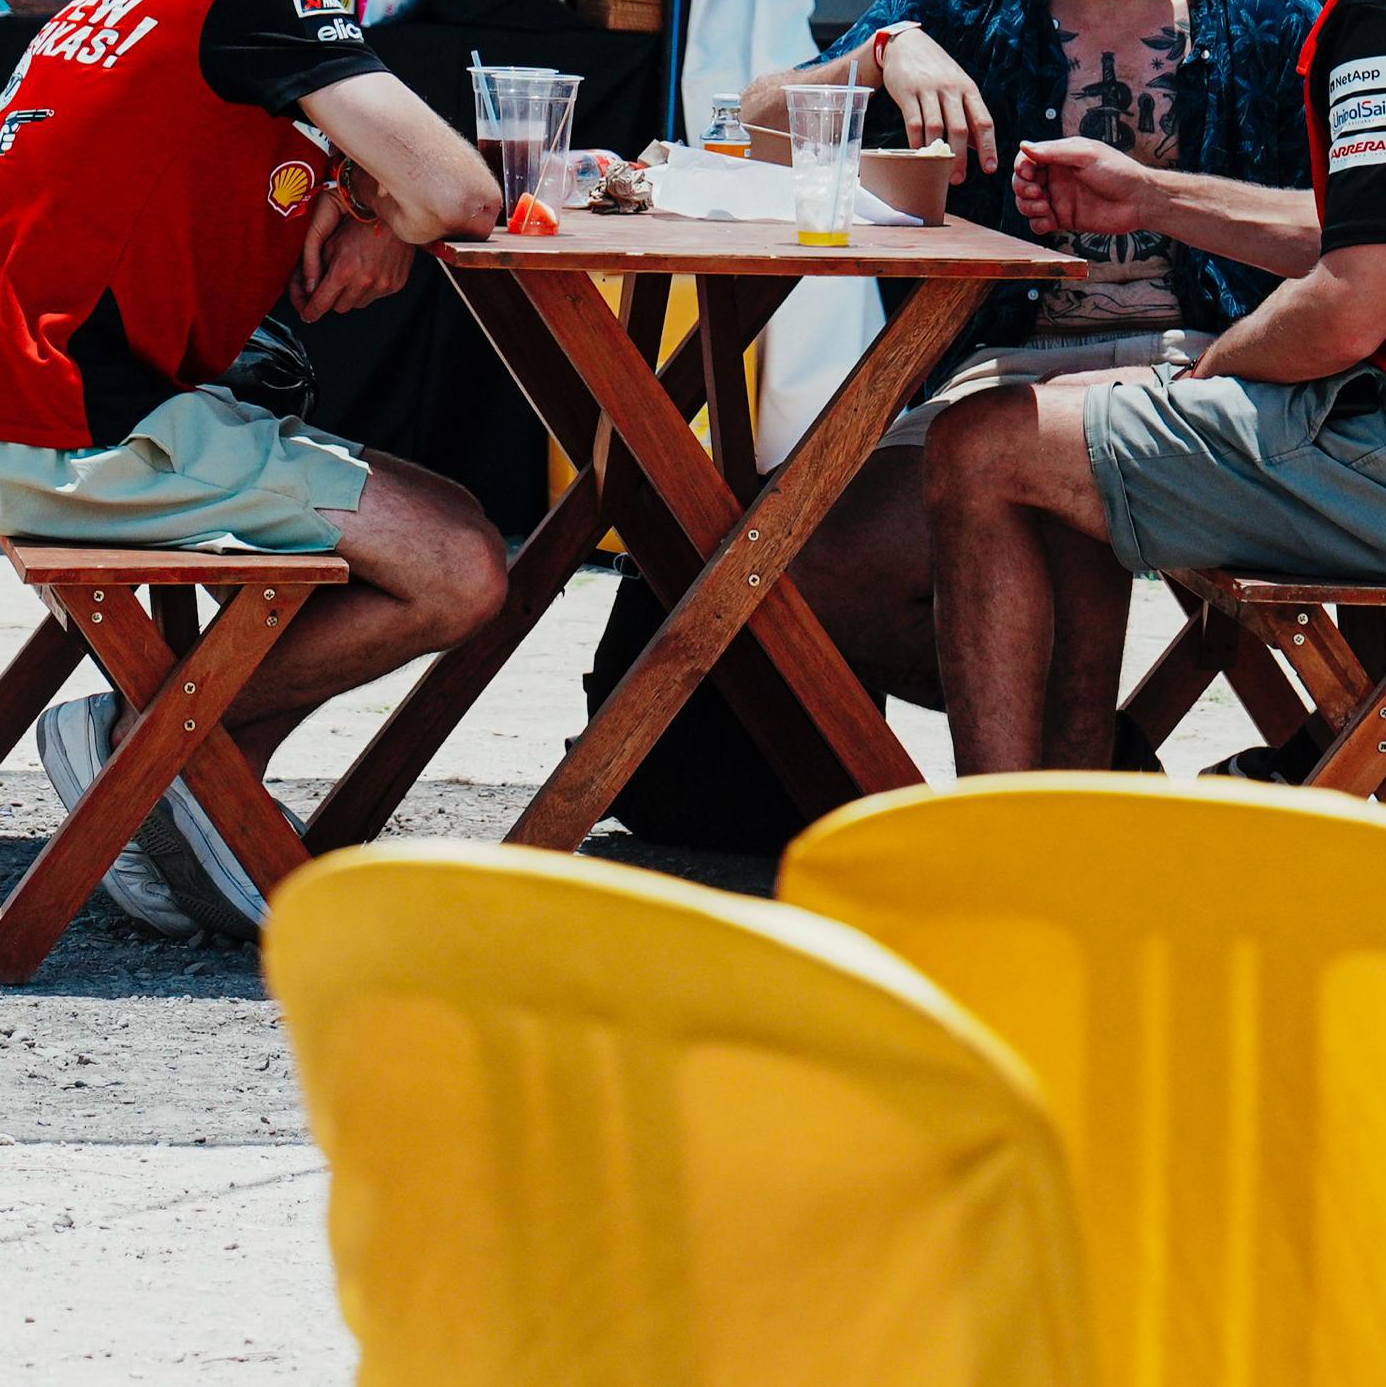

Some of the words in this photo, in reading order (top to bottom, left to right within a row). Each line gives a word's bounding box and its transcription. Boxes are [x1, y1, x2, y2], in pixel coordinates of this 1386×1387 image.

[1335, 69, 1381, 87] NetApp
[1333, 100, 1386, 129] UnipolSai
[1331, 140, 1386, 159] ARRERA
